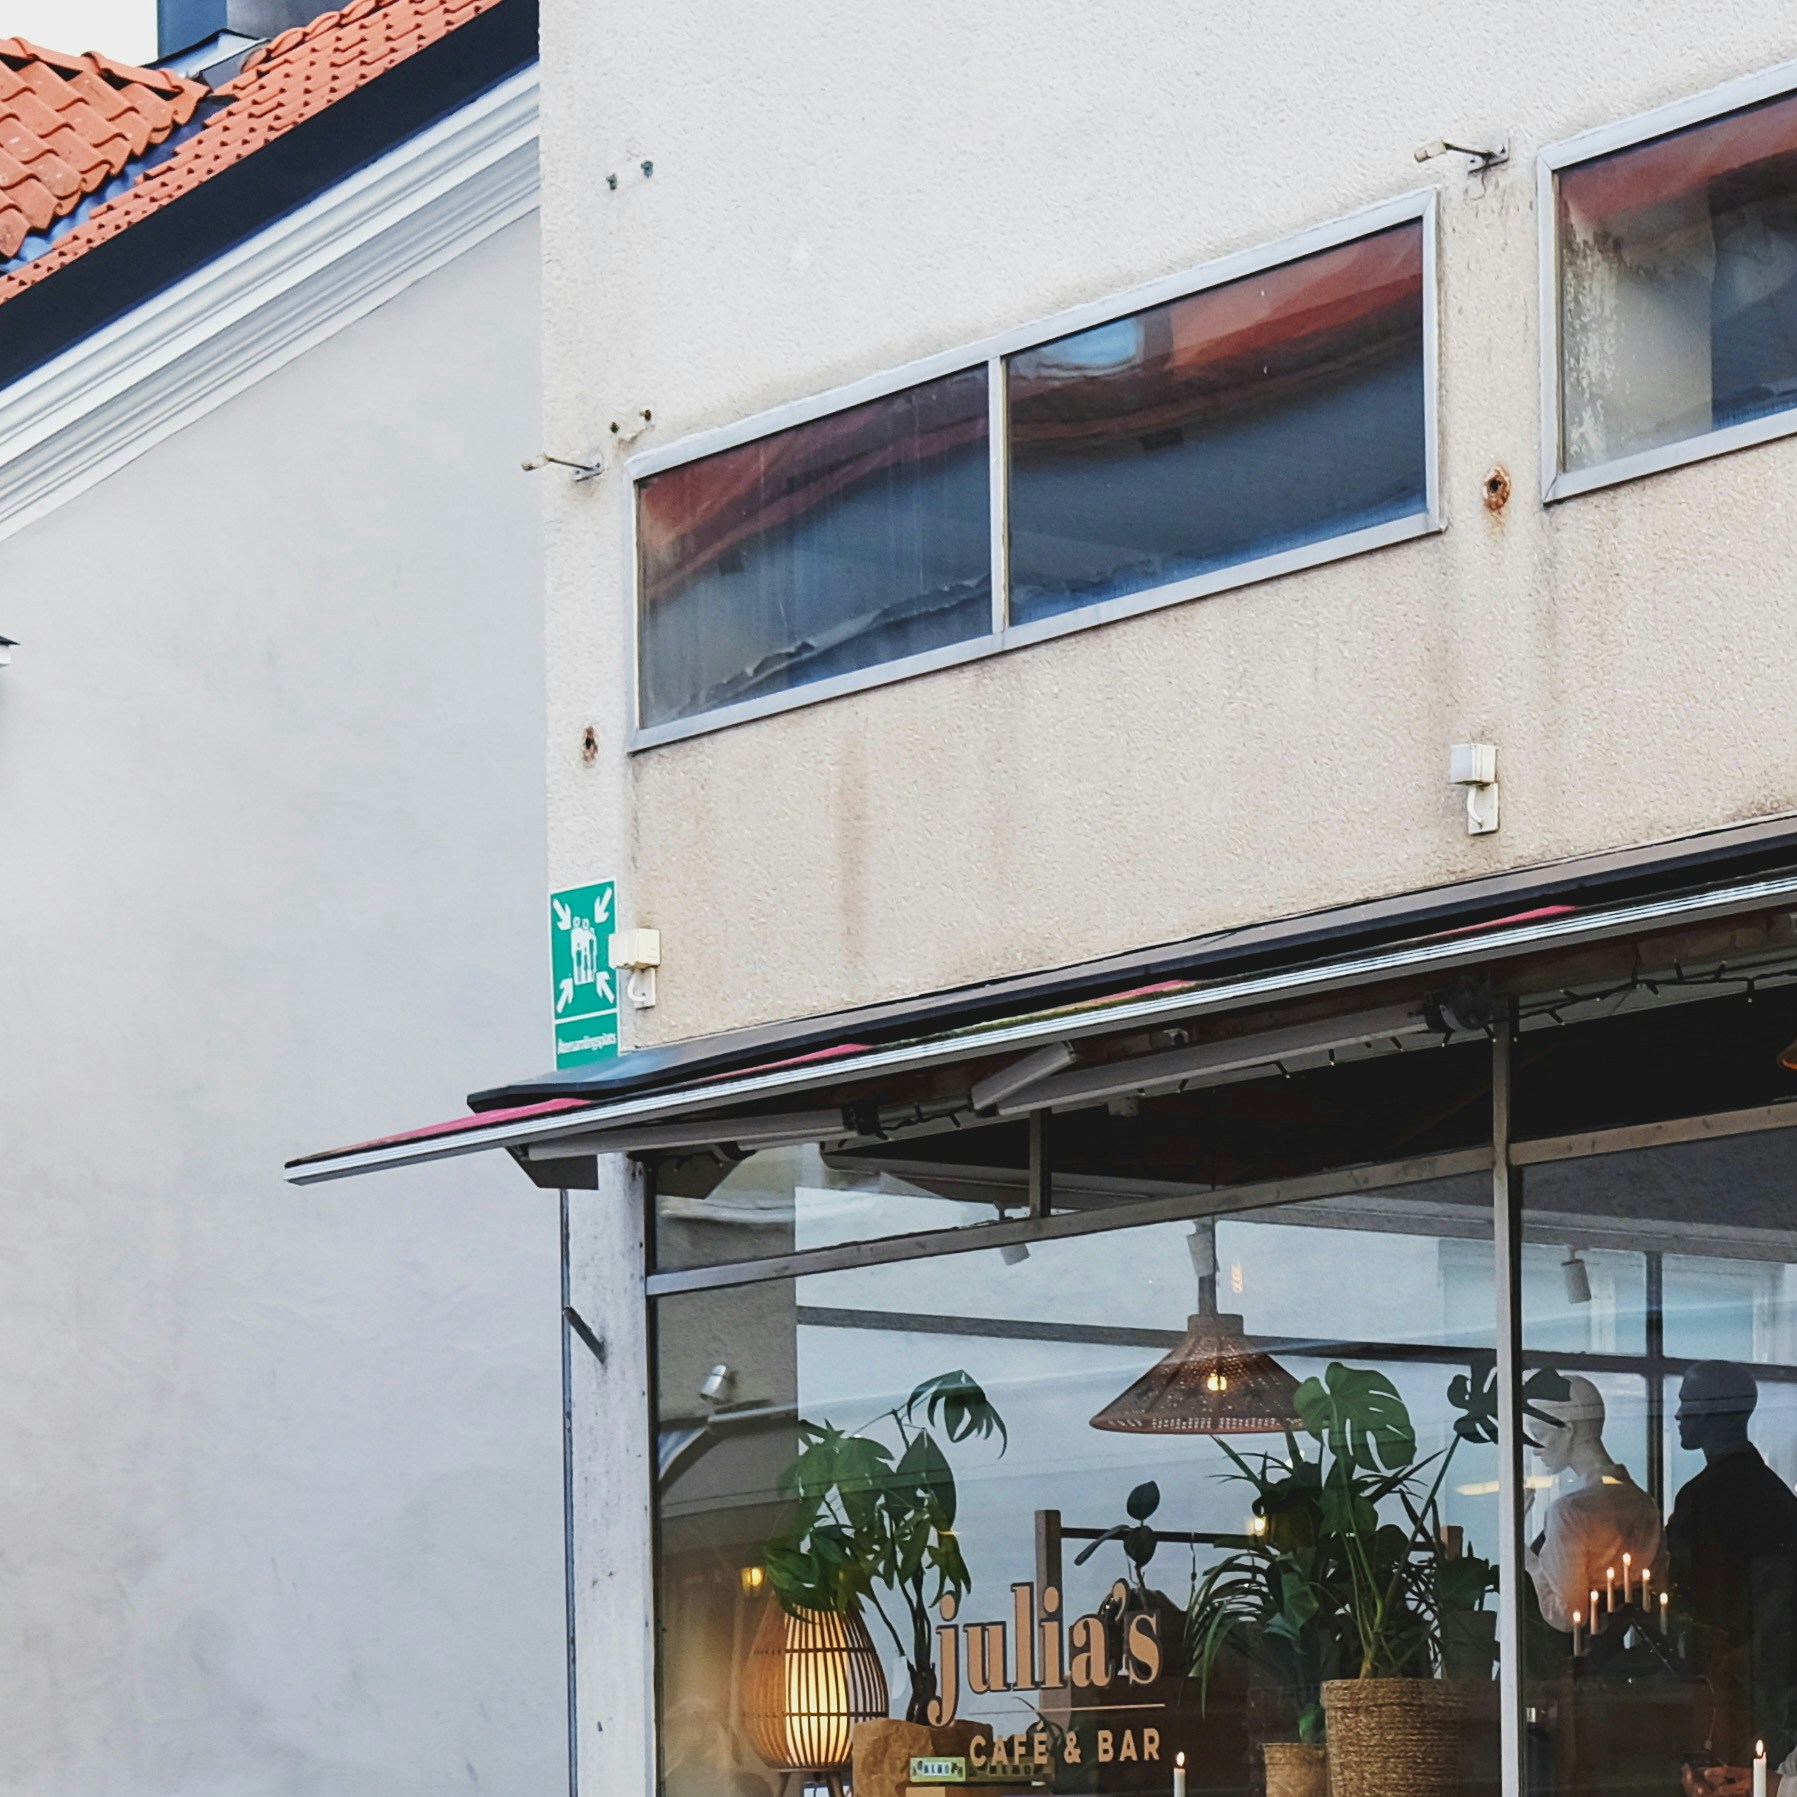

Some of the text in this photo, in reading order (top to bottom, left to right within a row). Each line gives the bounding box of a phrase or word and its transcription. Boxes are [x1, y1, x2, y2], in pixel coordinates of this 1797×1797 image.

[926, 1578, 1163, 1729] julia's
[969, 1721, 1161, 1766] CAFÉ & BAR
